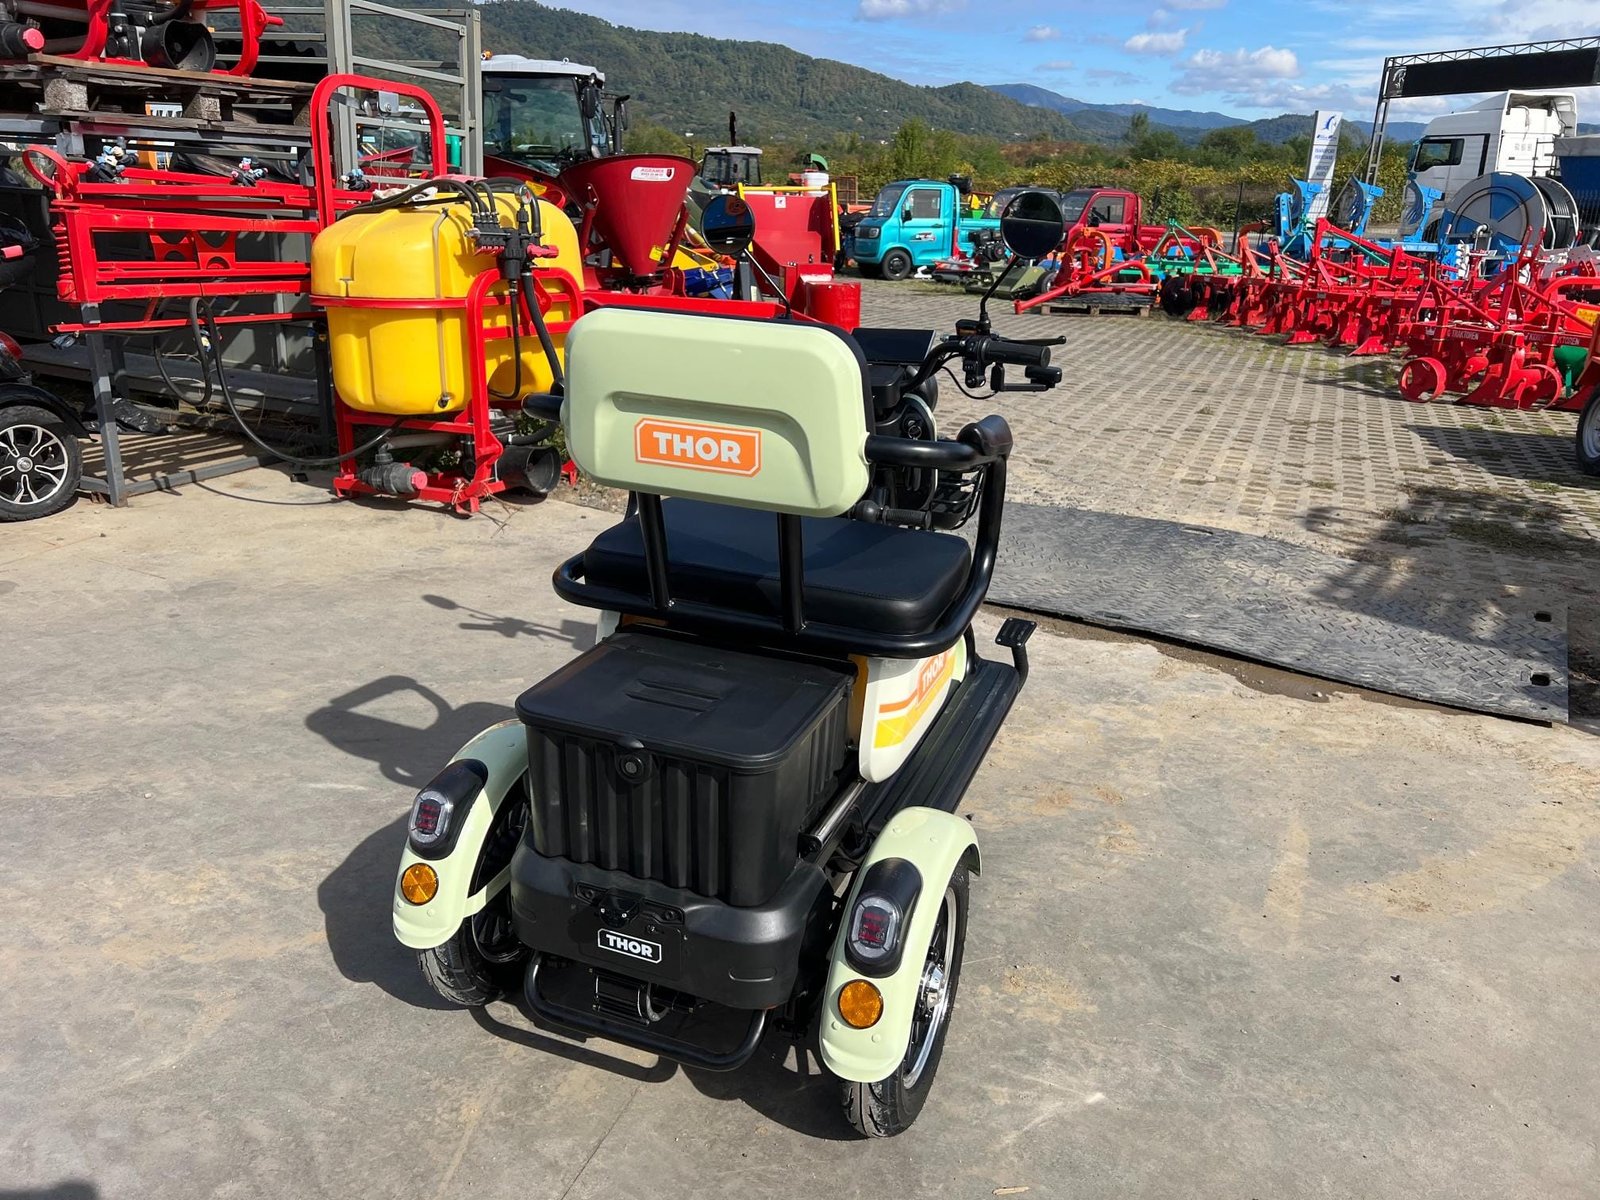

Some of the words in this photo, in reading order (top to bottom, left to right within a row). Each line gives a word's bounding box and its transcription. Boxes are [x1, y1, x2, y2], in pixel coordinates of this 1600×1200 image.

[652, 431, 741, 464] THOR
[922, 654, 945, 692] THOR
[606, 934, 653, 958] THOR
